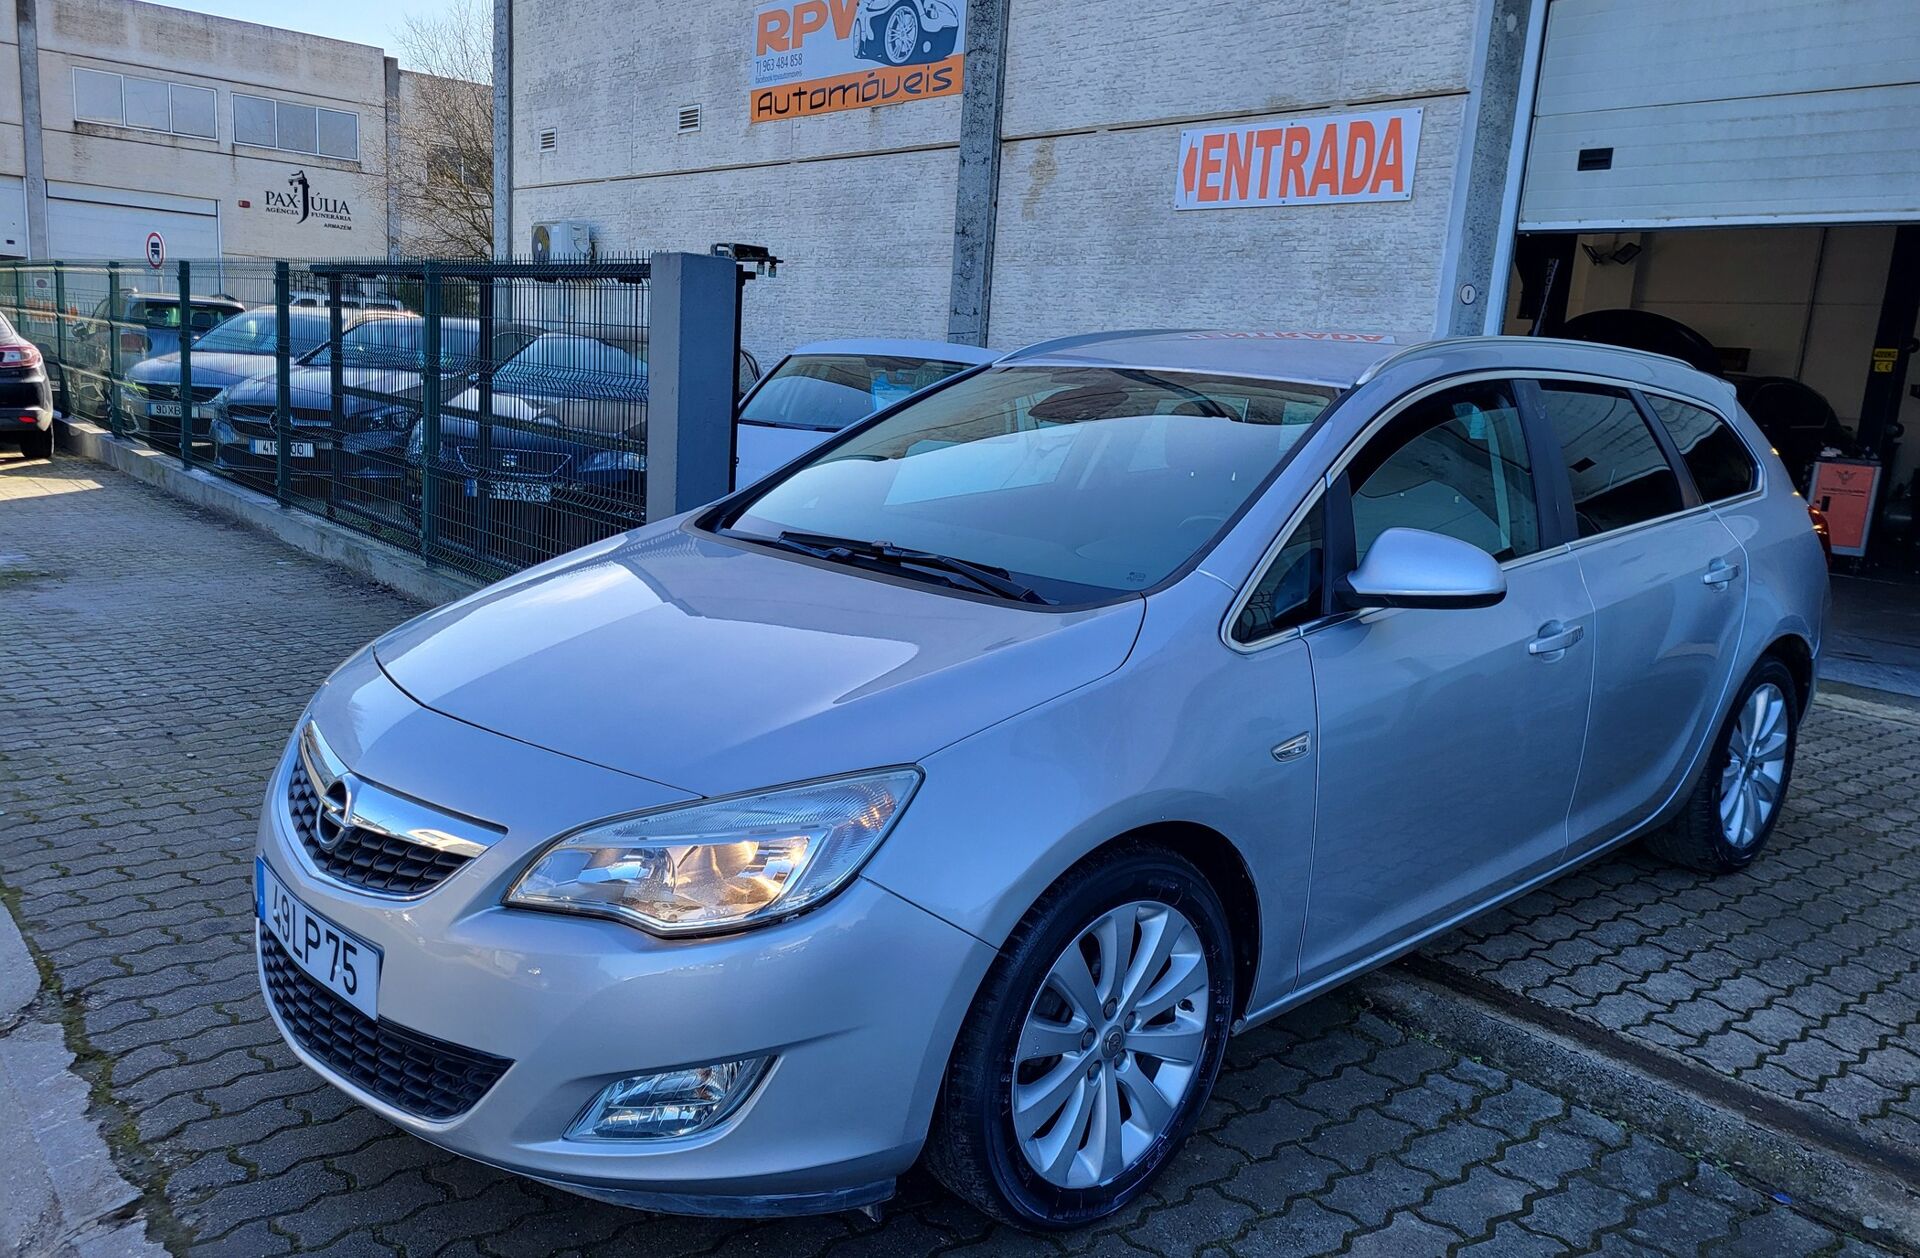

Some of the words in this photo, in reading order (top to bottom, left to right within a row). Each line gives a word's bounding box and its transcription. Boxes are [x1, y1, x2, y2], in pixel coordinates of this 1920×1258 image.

[763, 58, 774, 72] 963
[776, 55, 789, 69] 484
[790, 53, 803, 67] 858
[758, 65, 953, 117] Automóveis
[1197, 117, 1403, 202] ENTRADA
[323, 222, 352, 230] ARMAZÉM
